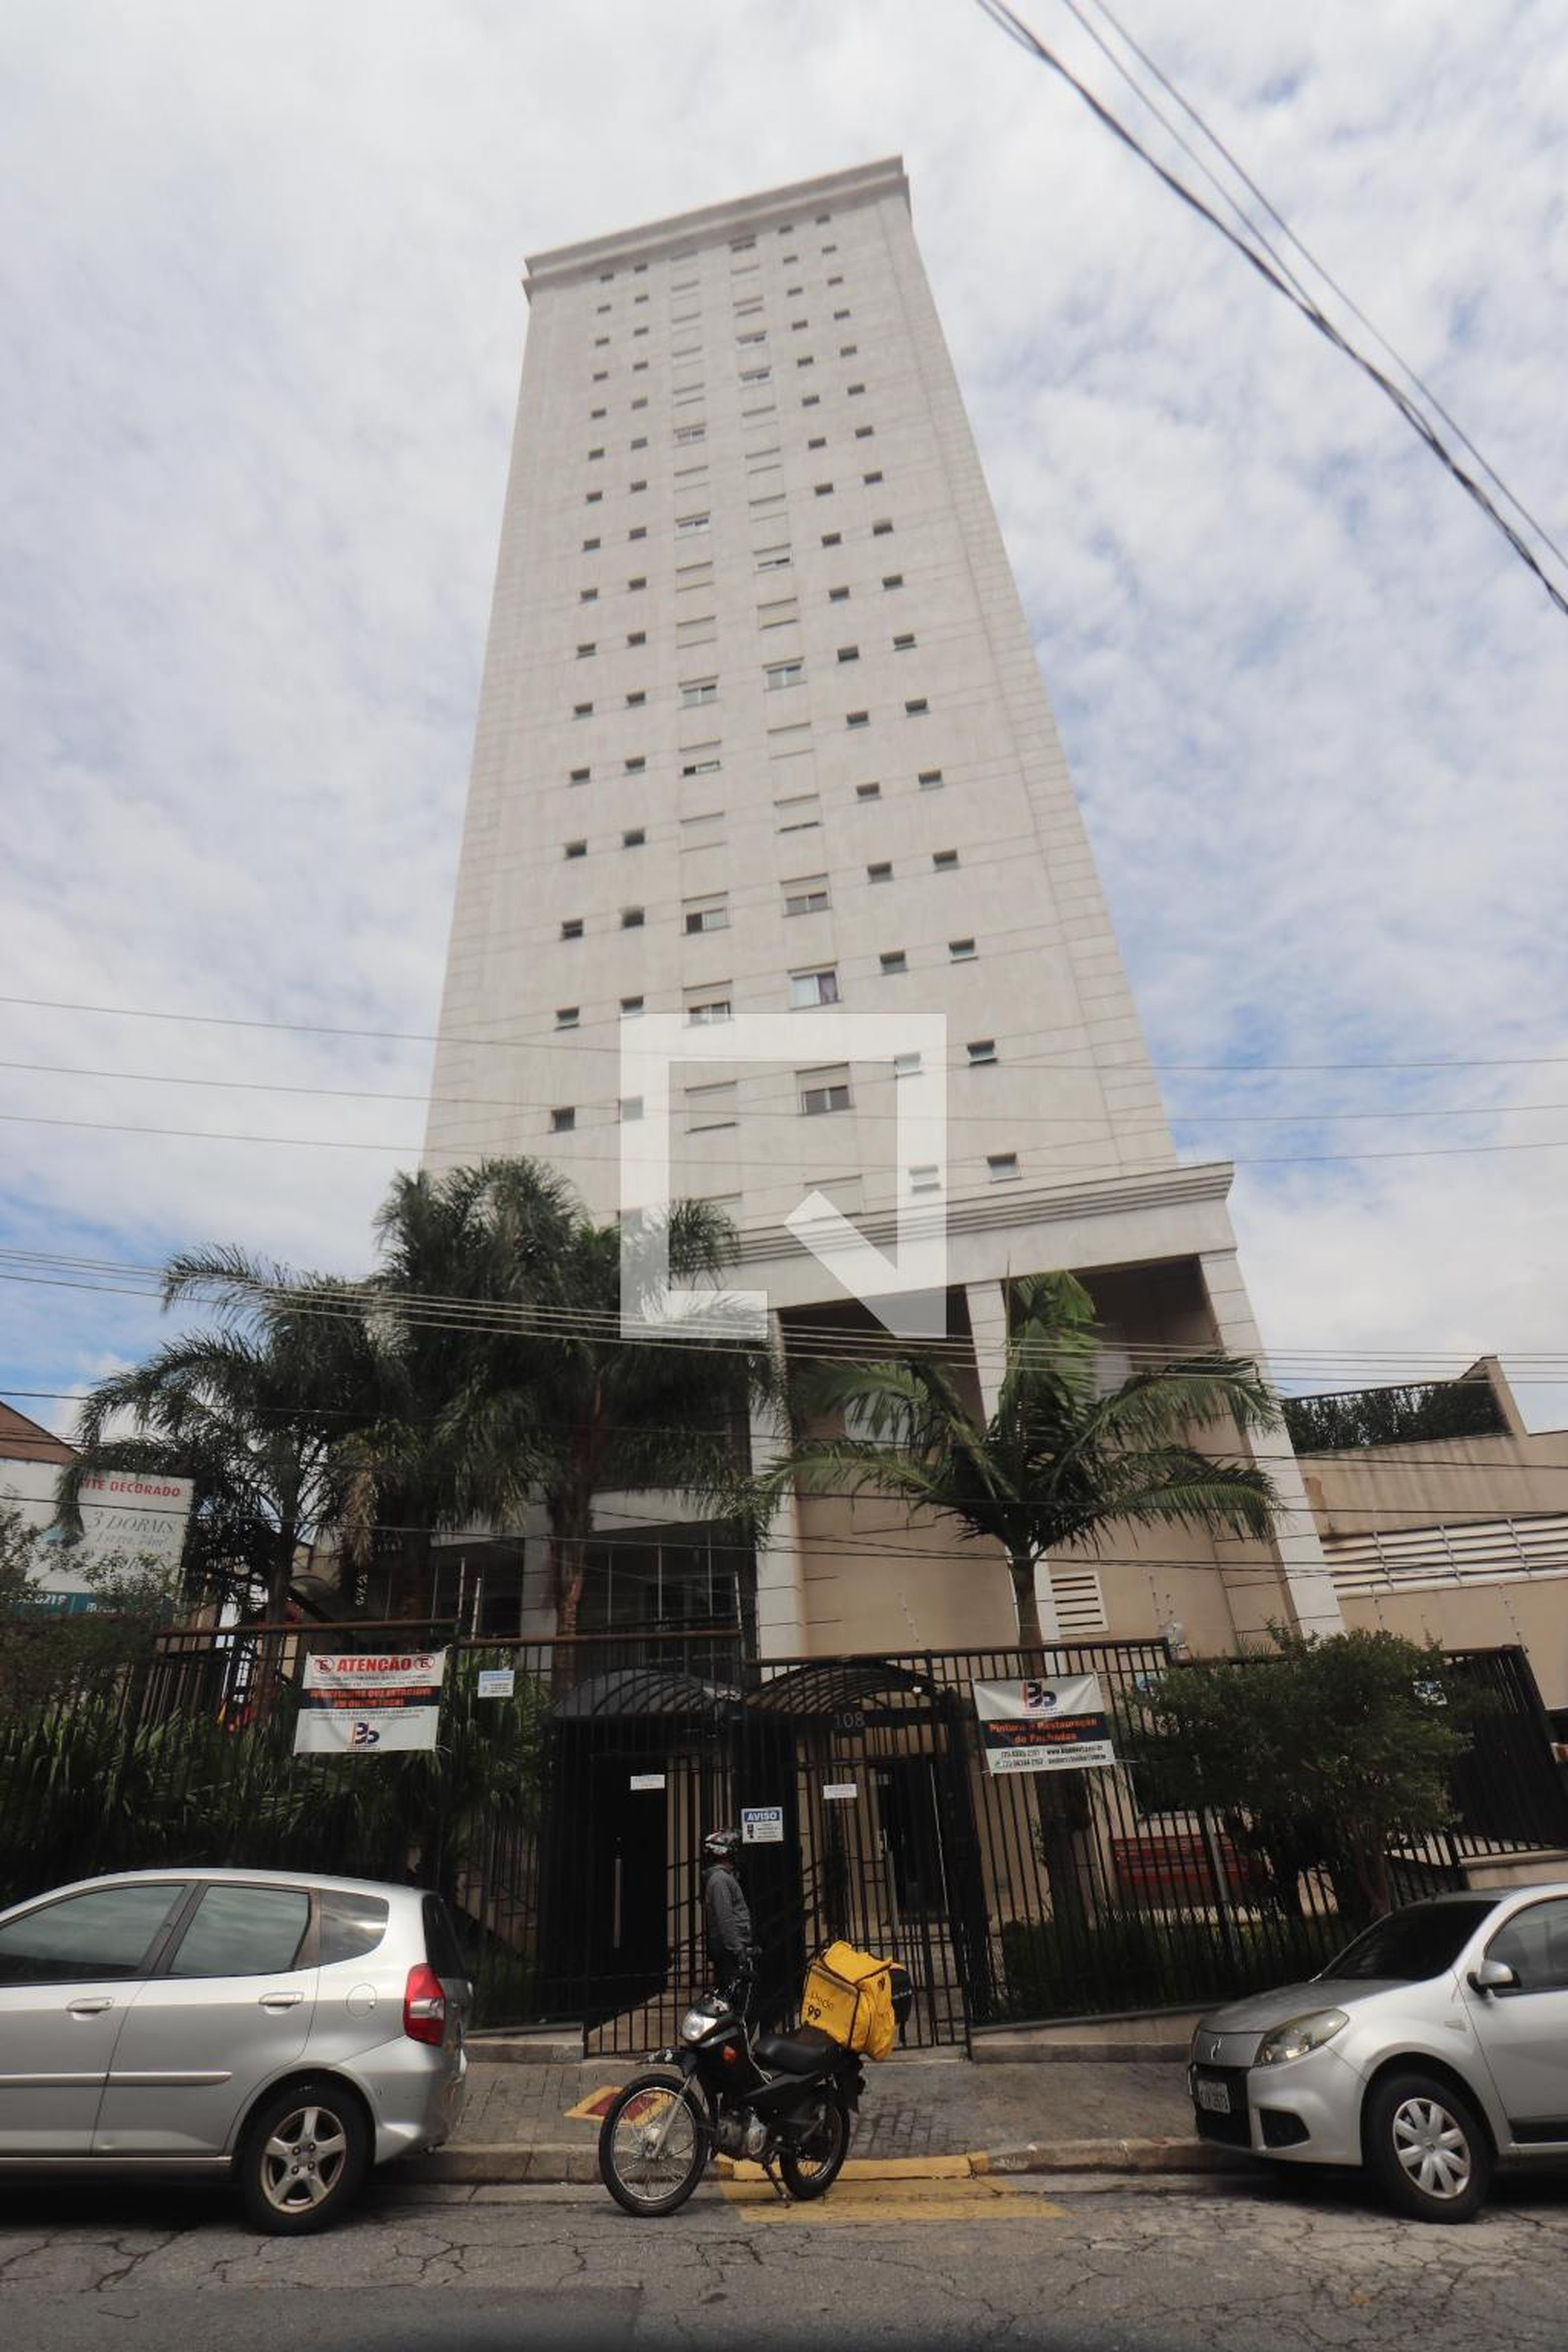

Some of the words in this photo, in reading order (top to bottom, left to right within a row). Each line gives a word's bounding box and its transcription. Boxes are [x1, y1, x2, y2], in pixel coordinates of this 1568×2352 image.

[110, 1480, 180, 1497] DECORADO
[833, 1711, 866, 1729] 108
[747, 1812, 777, 1821] AVISO
[808, 2005, 822, 2020] 99
